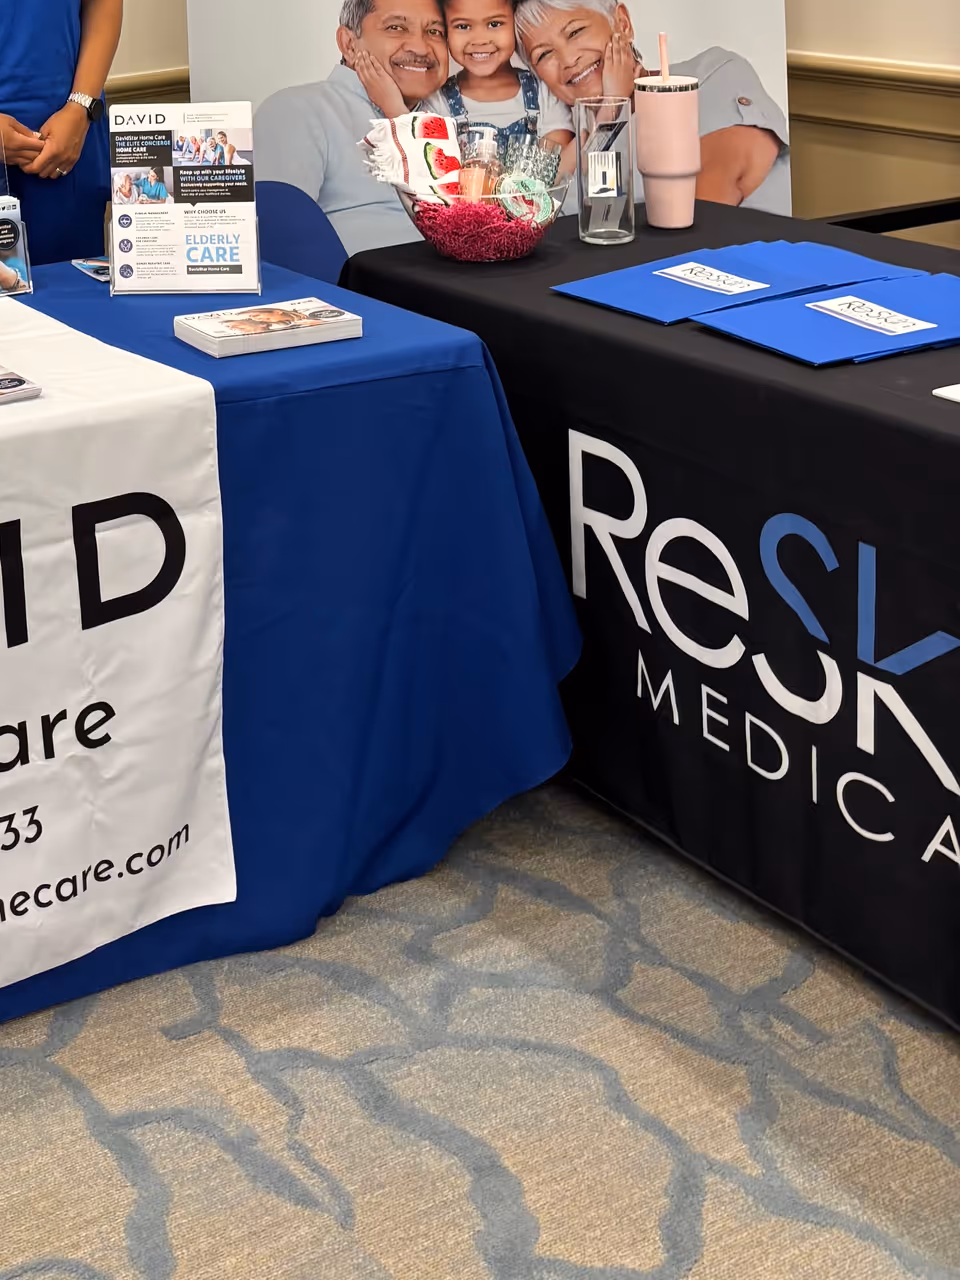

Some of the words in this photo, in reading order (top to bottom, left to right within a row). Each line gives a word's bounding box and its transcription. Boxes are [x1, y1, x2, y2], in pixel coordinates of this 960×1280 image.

[114, 114, 166, 126] DAVID
[185, 233, 241, 245] ELDERLY
[186, 246, 240, 263] CARE
